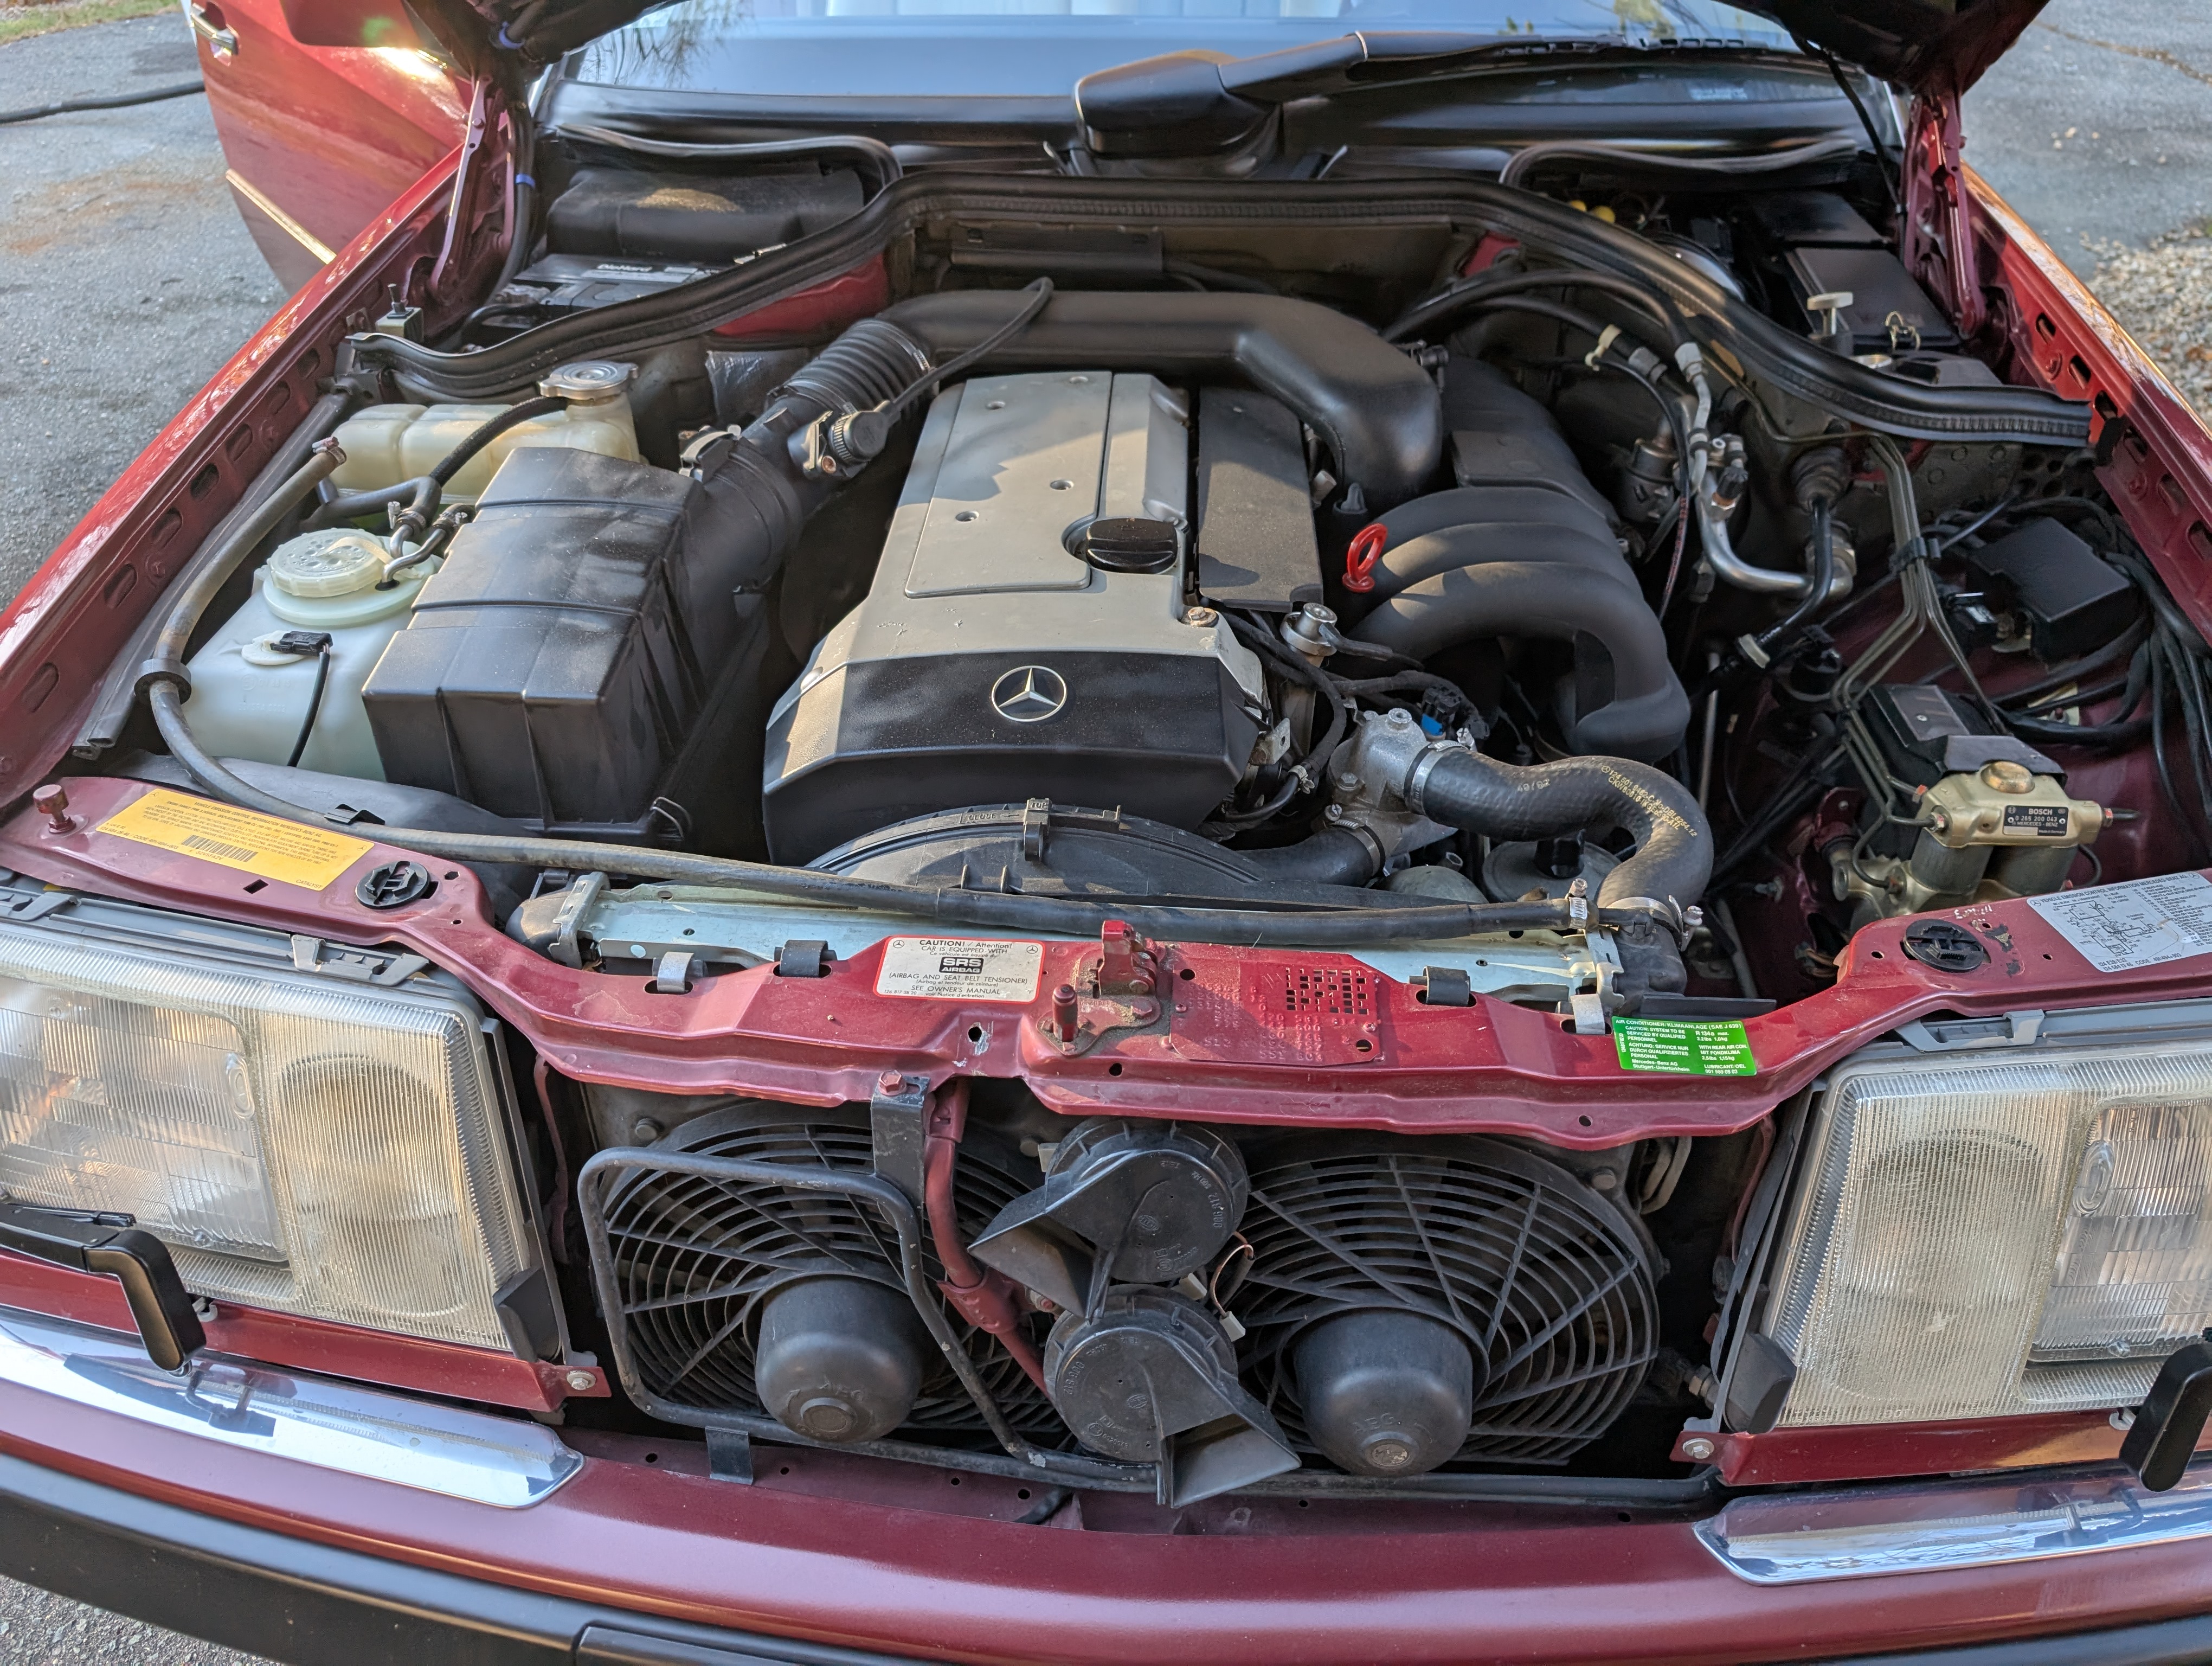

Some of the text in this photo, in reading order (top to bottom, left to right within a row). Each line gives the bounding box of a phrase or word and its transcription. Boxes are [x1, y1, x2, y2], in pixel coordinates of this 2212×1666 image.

[1609, 770, 1621, 779] 124
[1621, 777, 1633, 786] 501
[250, 816, 280, 826] INFORMATION
[279, 823, 316, 835] MERCEDES-BENZ
[294, 879, 323, 889] CATALYST
[2107, 882, 2140, 891] INFORMATION
[2139, 875, 2179, 886] MERCEDES-BENZ
[942, 958, 981, 967] SRS
[984, 976, 1027, 984] TENSIONER)
